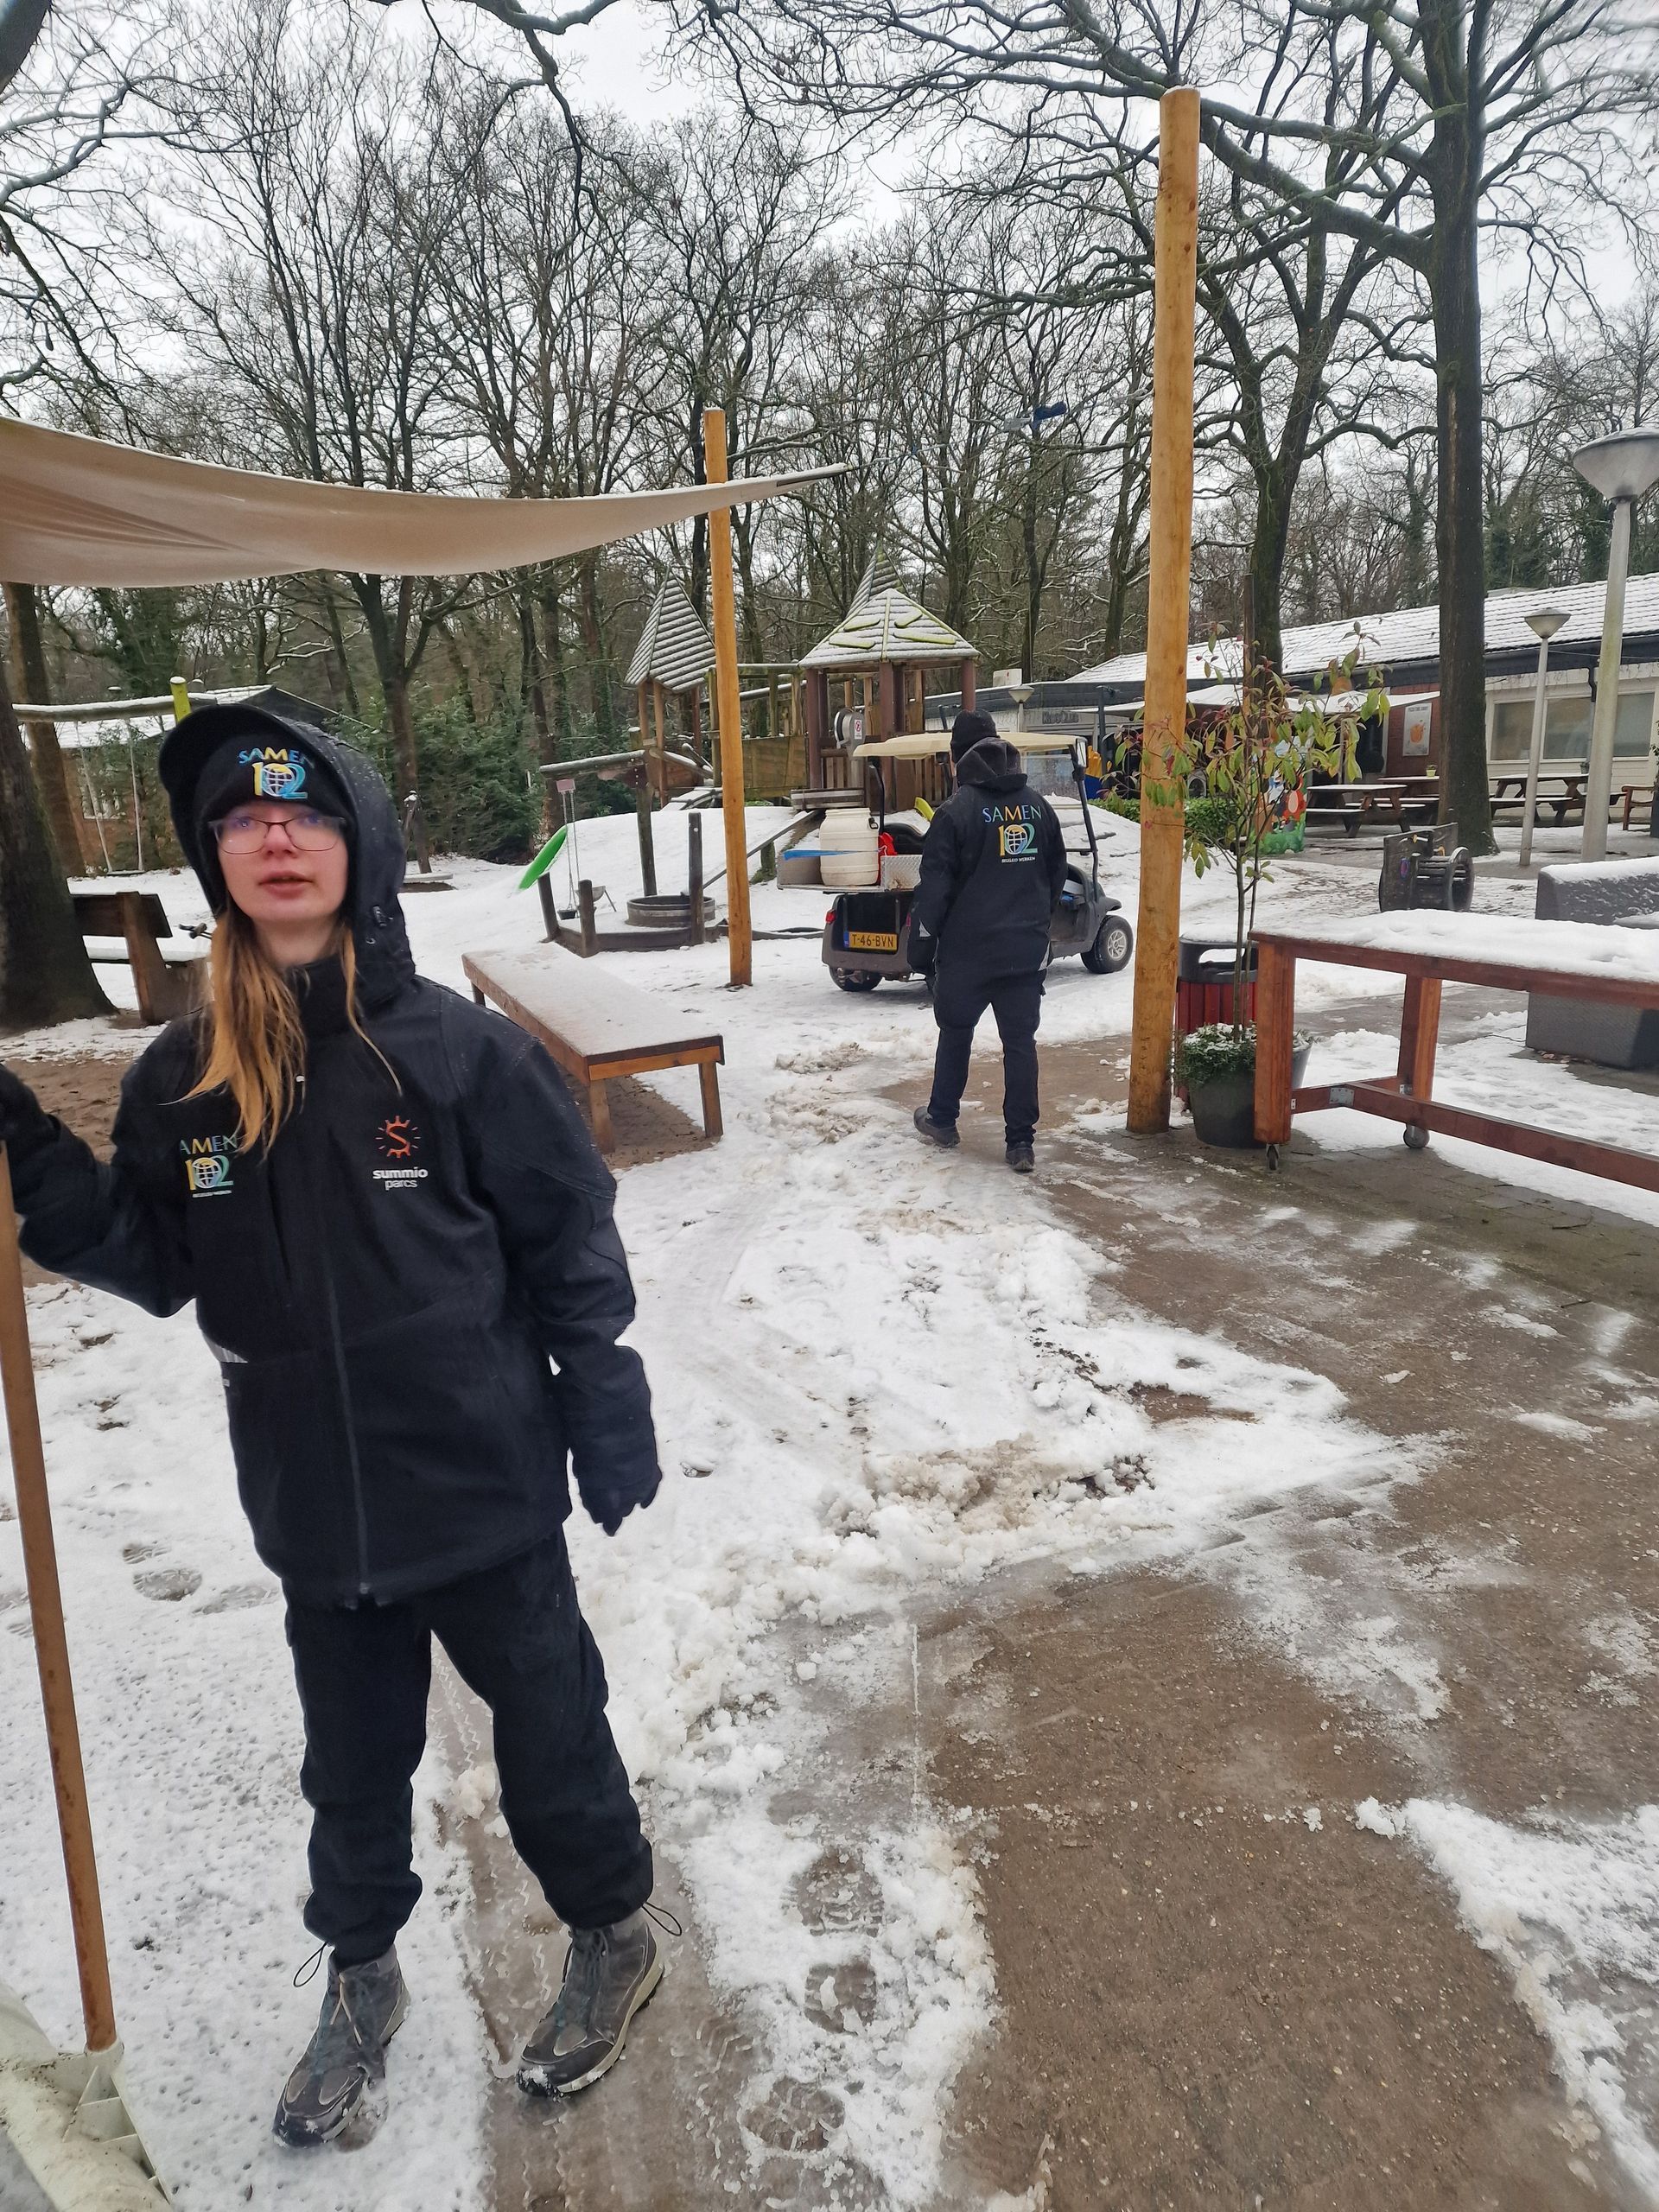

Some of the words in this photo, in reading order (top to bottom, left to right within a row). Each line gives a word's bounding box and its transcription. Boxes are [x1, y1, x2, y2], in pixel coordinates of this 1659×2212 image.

[251, 763, 308, 798] 102
[982, 804, 1042, 823] SAMEN
[998, 823, 1038, 856] 102
[852, 934, 893, 947] T-46-BVN
[180, 1135, 238, 1154] AMEN
[185, 1155, 233, 1190] 102
[372, 1166, 429, 1179] summio
[385, 1179, 417, 1191] parcs
